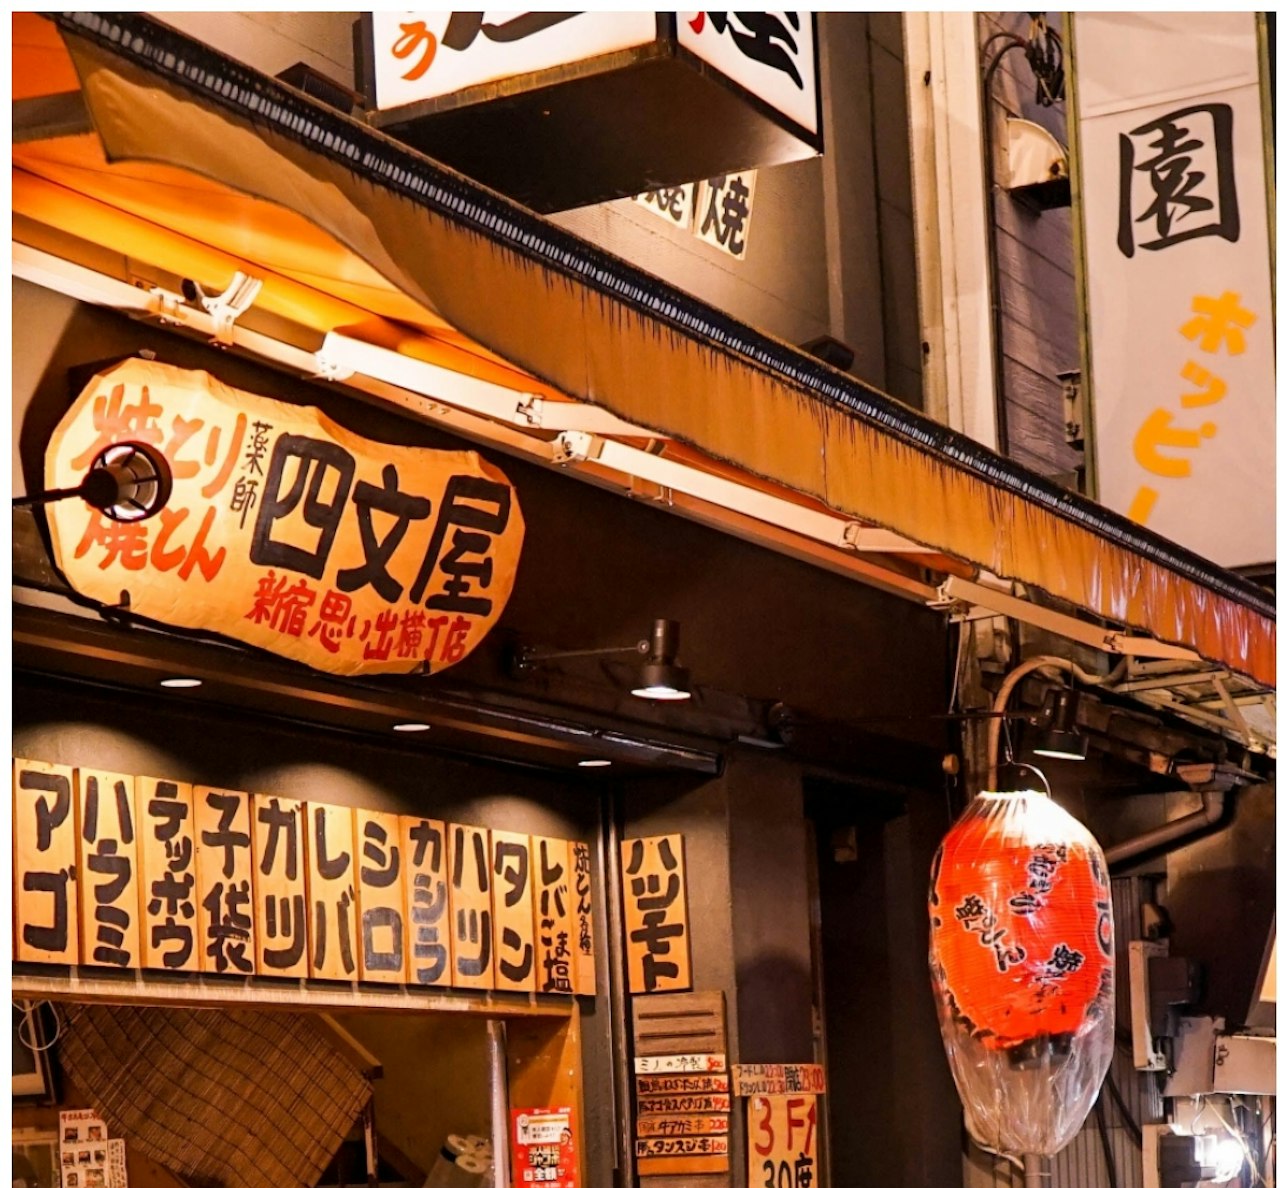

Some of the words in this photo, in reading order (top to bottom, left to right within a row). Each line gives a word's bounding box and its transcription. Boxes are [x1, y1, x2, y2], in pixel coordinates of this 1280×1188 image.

[1117, 102, 1240, 259] 園
[230, 420, 274, 530] 薬師
[250, 432, 512, 618] 四文屋
[244, 570, 472, 664] 新宿思い出横丁店
[19, 769, 77, 953] アゴ
[83, 775, 134, 967] ハラミ
[147, 781, 196, 969] テッポウ
[201, 792, 254, 973] 子袋
[258, 798, 306, 970] ガツ
[361, 820, 404, 973] シロ
[409, 820, 448, 985] カシラ
[453, 827, 491, 977] ハツ
[494, 840, 534, 983] タン
[626, 838, 684, 992] ハツモト
